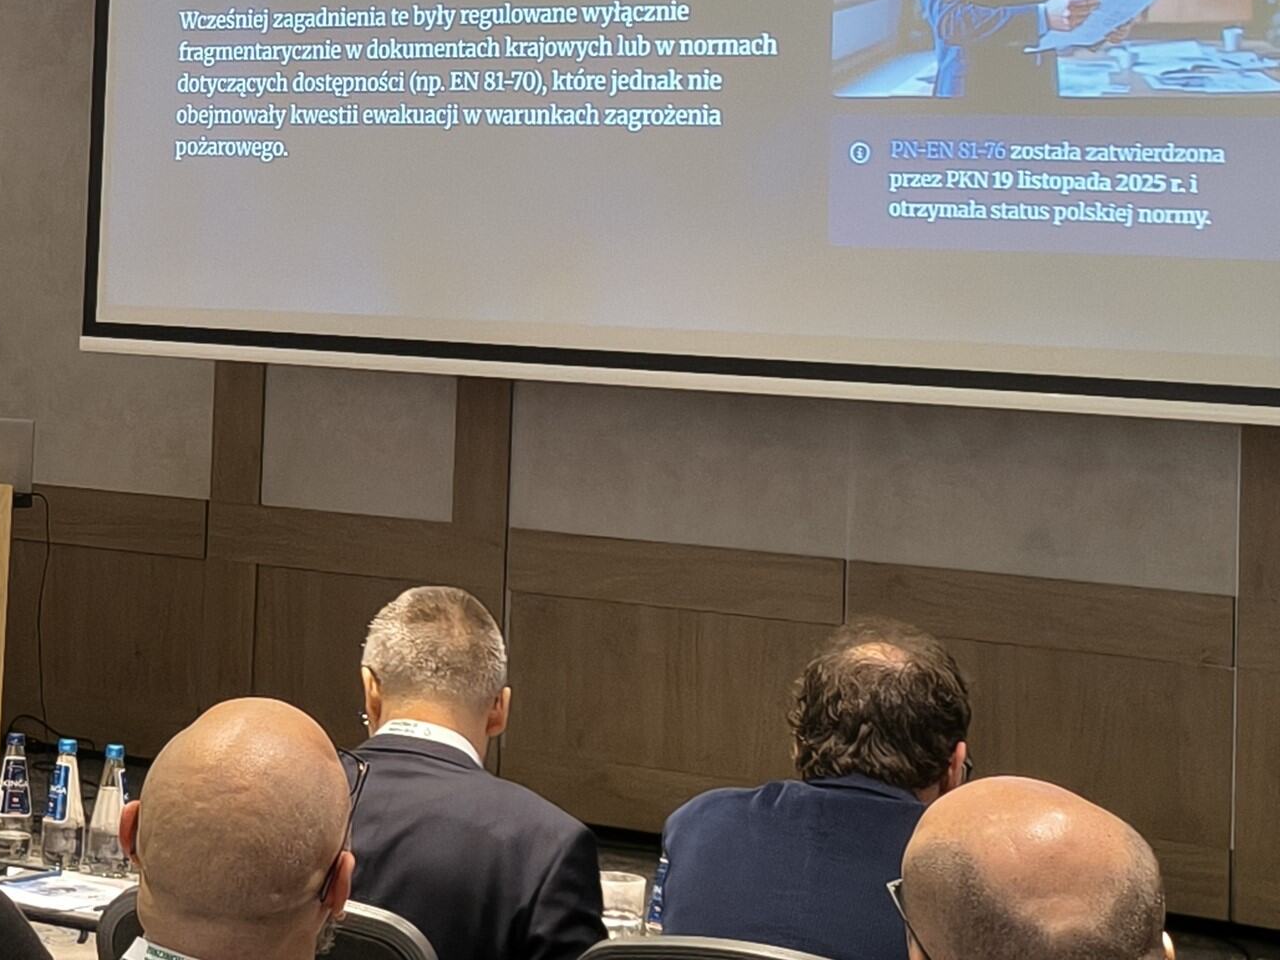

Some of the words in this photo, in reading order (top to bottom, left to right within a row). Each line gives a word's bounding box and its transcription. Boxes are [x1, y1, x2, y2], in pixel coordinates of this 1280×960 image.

[179, 7, 269, 34] Wcześniej
[271, 5, 387, 33] zagadnienia
[391, 8, 409, 27] te
[412, 4, 456, 32] były
[459, 2, 578, 30] regulowane
[581, 0, 690, 28] wyłącznie
[178, 39, 342, 67] fragmentarycznie
[345, 45, 361, 60] w
[365, 36, 500, 61] dokumentach
[504, 35, 614, 63] krajowych
[616, 34, 651, 58] lub
[655, 40, 673, 57] w
[678, 32, 779, 57] normach
[177, 72, 289, 98] dotyczących
[292, 70, 405, 97] dostępności
[408, 70, 446, 97] (np.
[448, 70, 480, 92] EN
[483, 70, 549, 96] 81-70),
[551, 67, 607, 92] które
[608, 68, 683, 97] jednak
[687, 68, 723, 91] nie
[175, 102, 288, 129] obejmowały
[289, 103, 360, 126] kwestii
[362, 103, 460, 131] ewakuacji
[462, 109, 483, 125] w
[486, 102, 601, 126] warunkach
[604, 103, 722, 132] zagrożenia
[175, 136, 289, 162] pożarowego.
[890, 140, 955, 160] PN-EN
[958, 140, 1007, 160] 81-76
[1009, 141, 1083, 162] została
[1084, 142, 1226, 164] zatwierdzona
[888, 172, 944, 193] przez
[945, 170, 990, 189] PKN
[993, 171, 1014, 190] 19
[1017, 169, 1113, 196] listopada
[1115, 172, 1168, 193] 2025
[1170, 178, 1187, 194] r.
[1188, 173, 1200, 194] i
[888, 199, 988, 223] otrzymała
[990, 202, 1051, 220] status
[1052, 201, 1135, 227] polskiej
[1136, 206, 1213, 230] normy.
